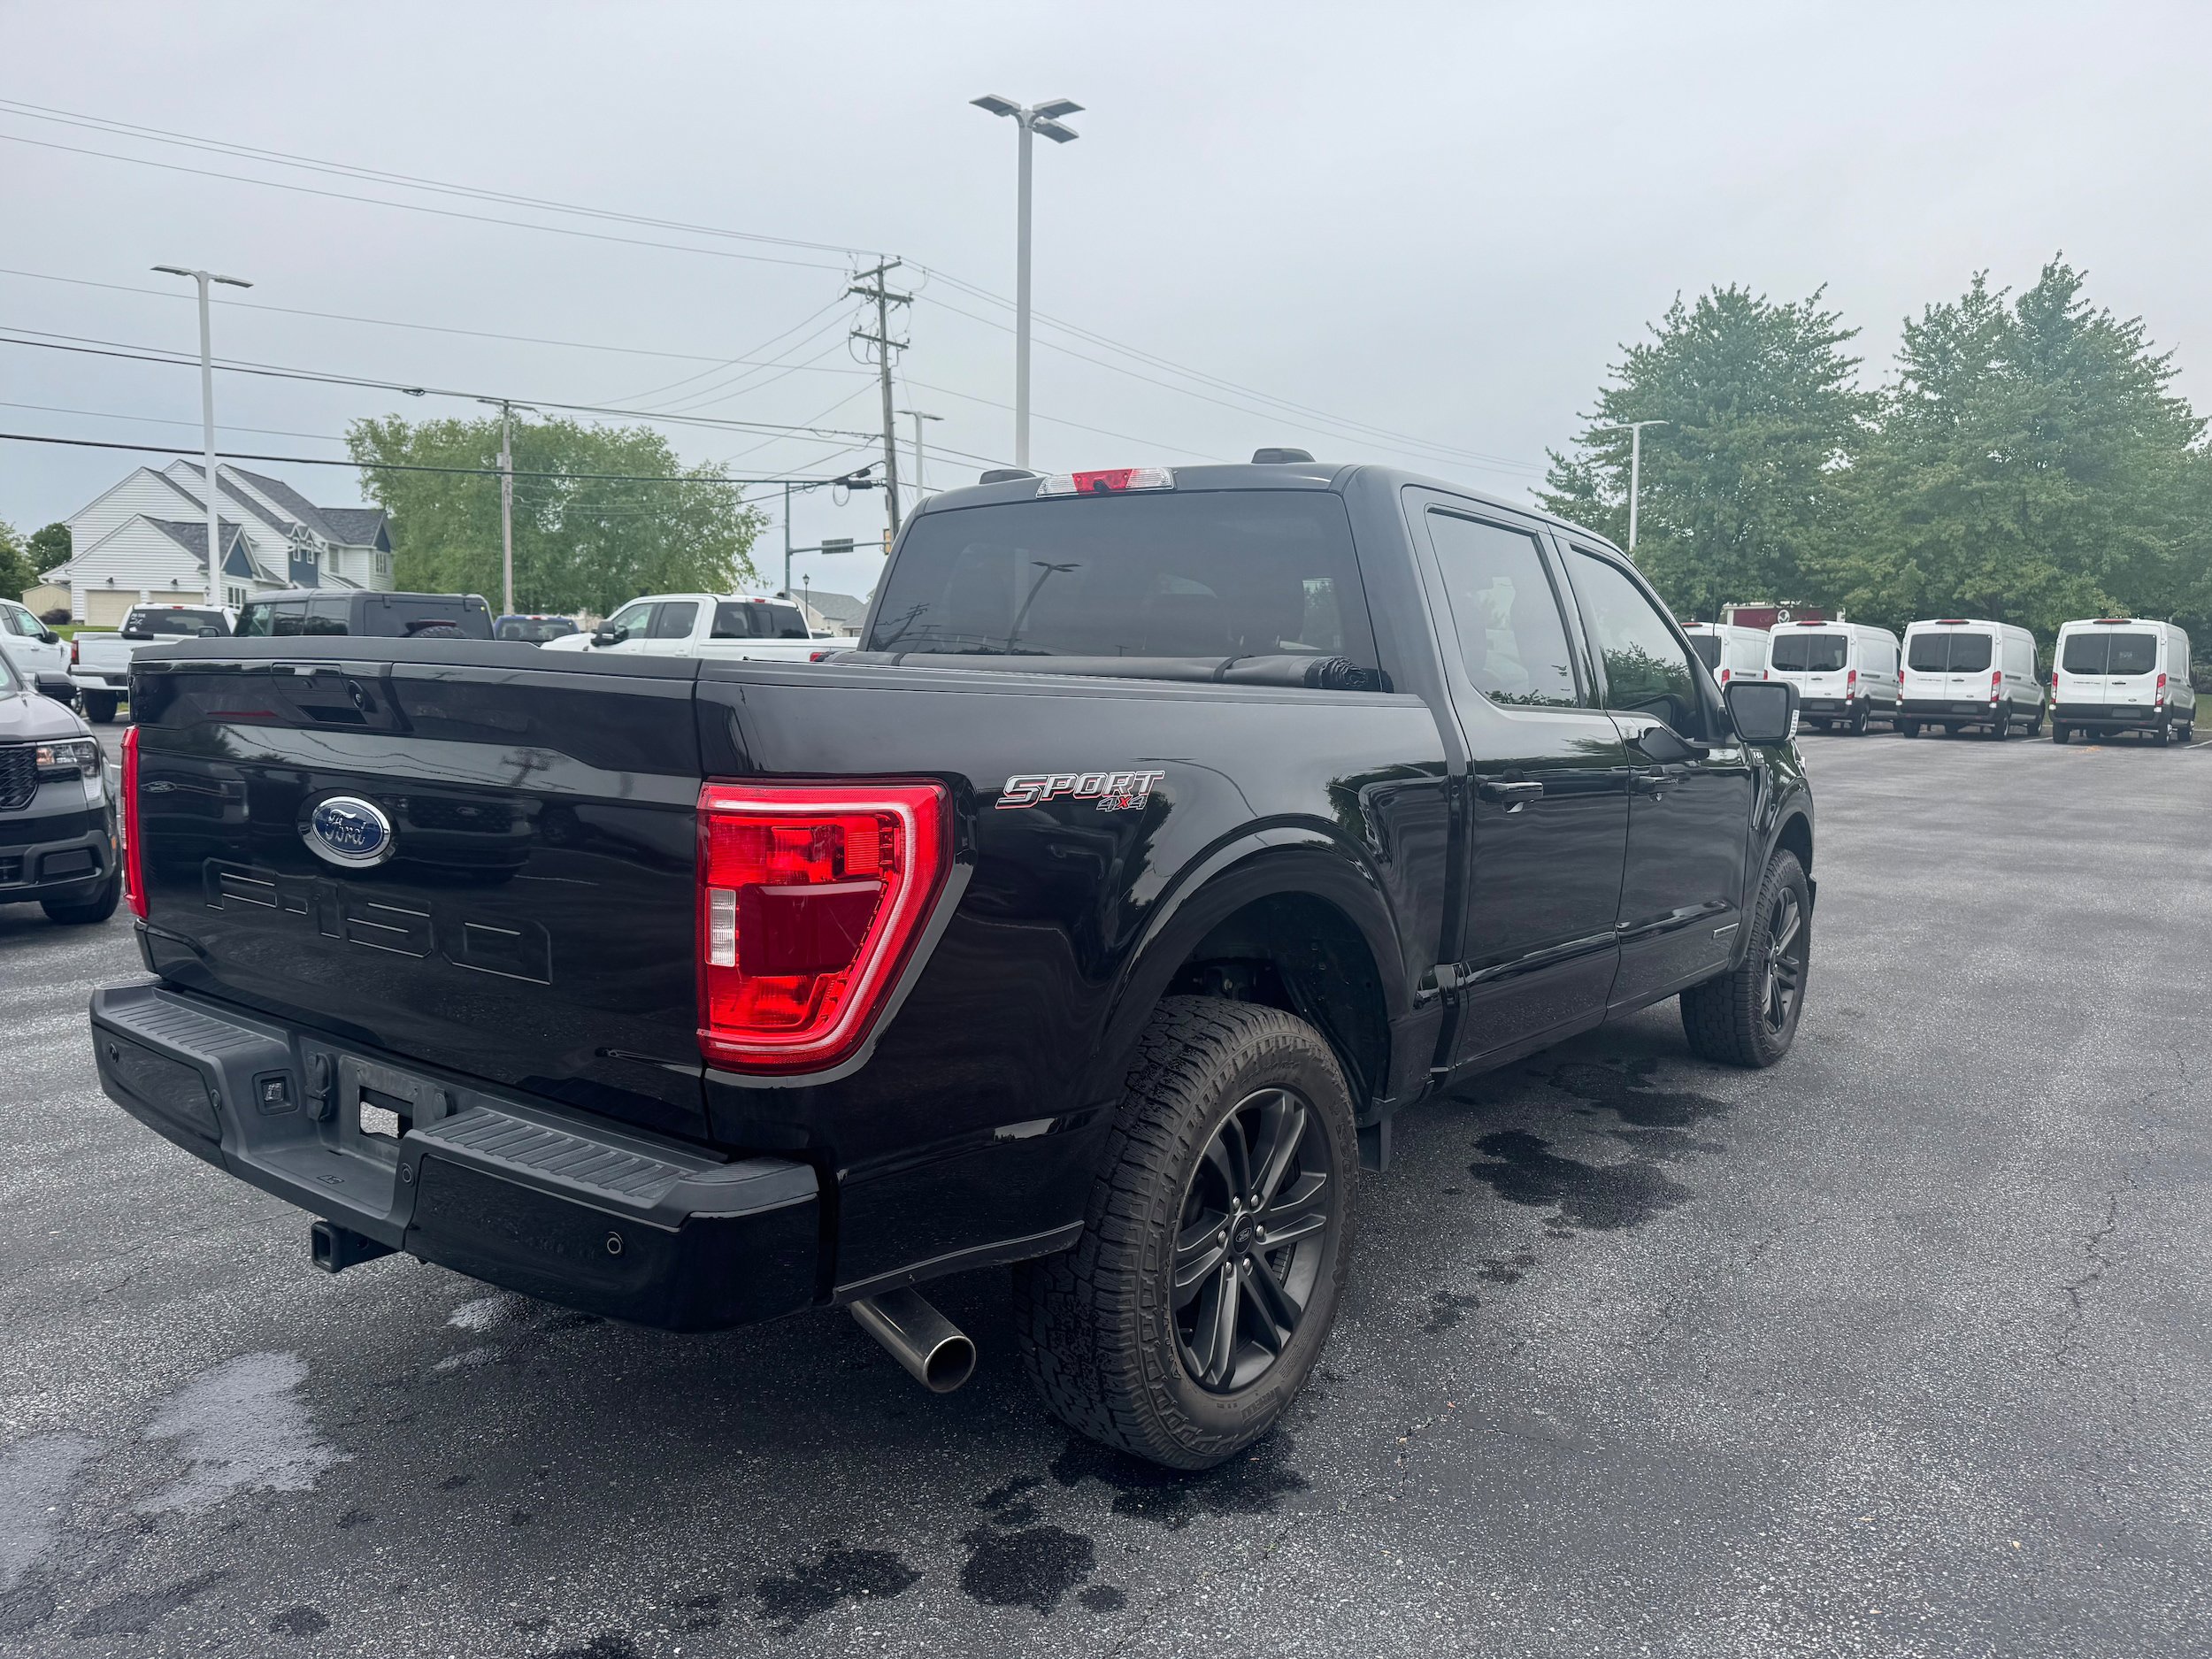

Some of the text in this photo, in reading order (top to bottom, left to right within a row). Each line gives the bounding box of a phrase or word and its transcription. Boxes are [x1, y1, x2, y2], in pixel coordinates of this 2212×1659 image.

[995, 770, 1166, 810] SPORT
[325, 809, 367, 846] Ford
[202, 856, 553, 986] F-150
